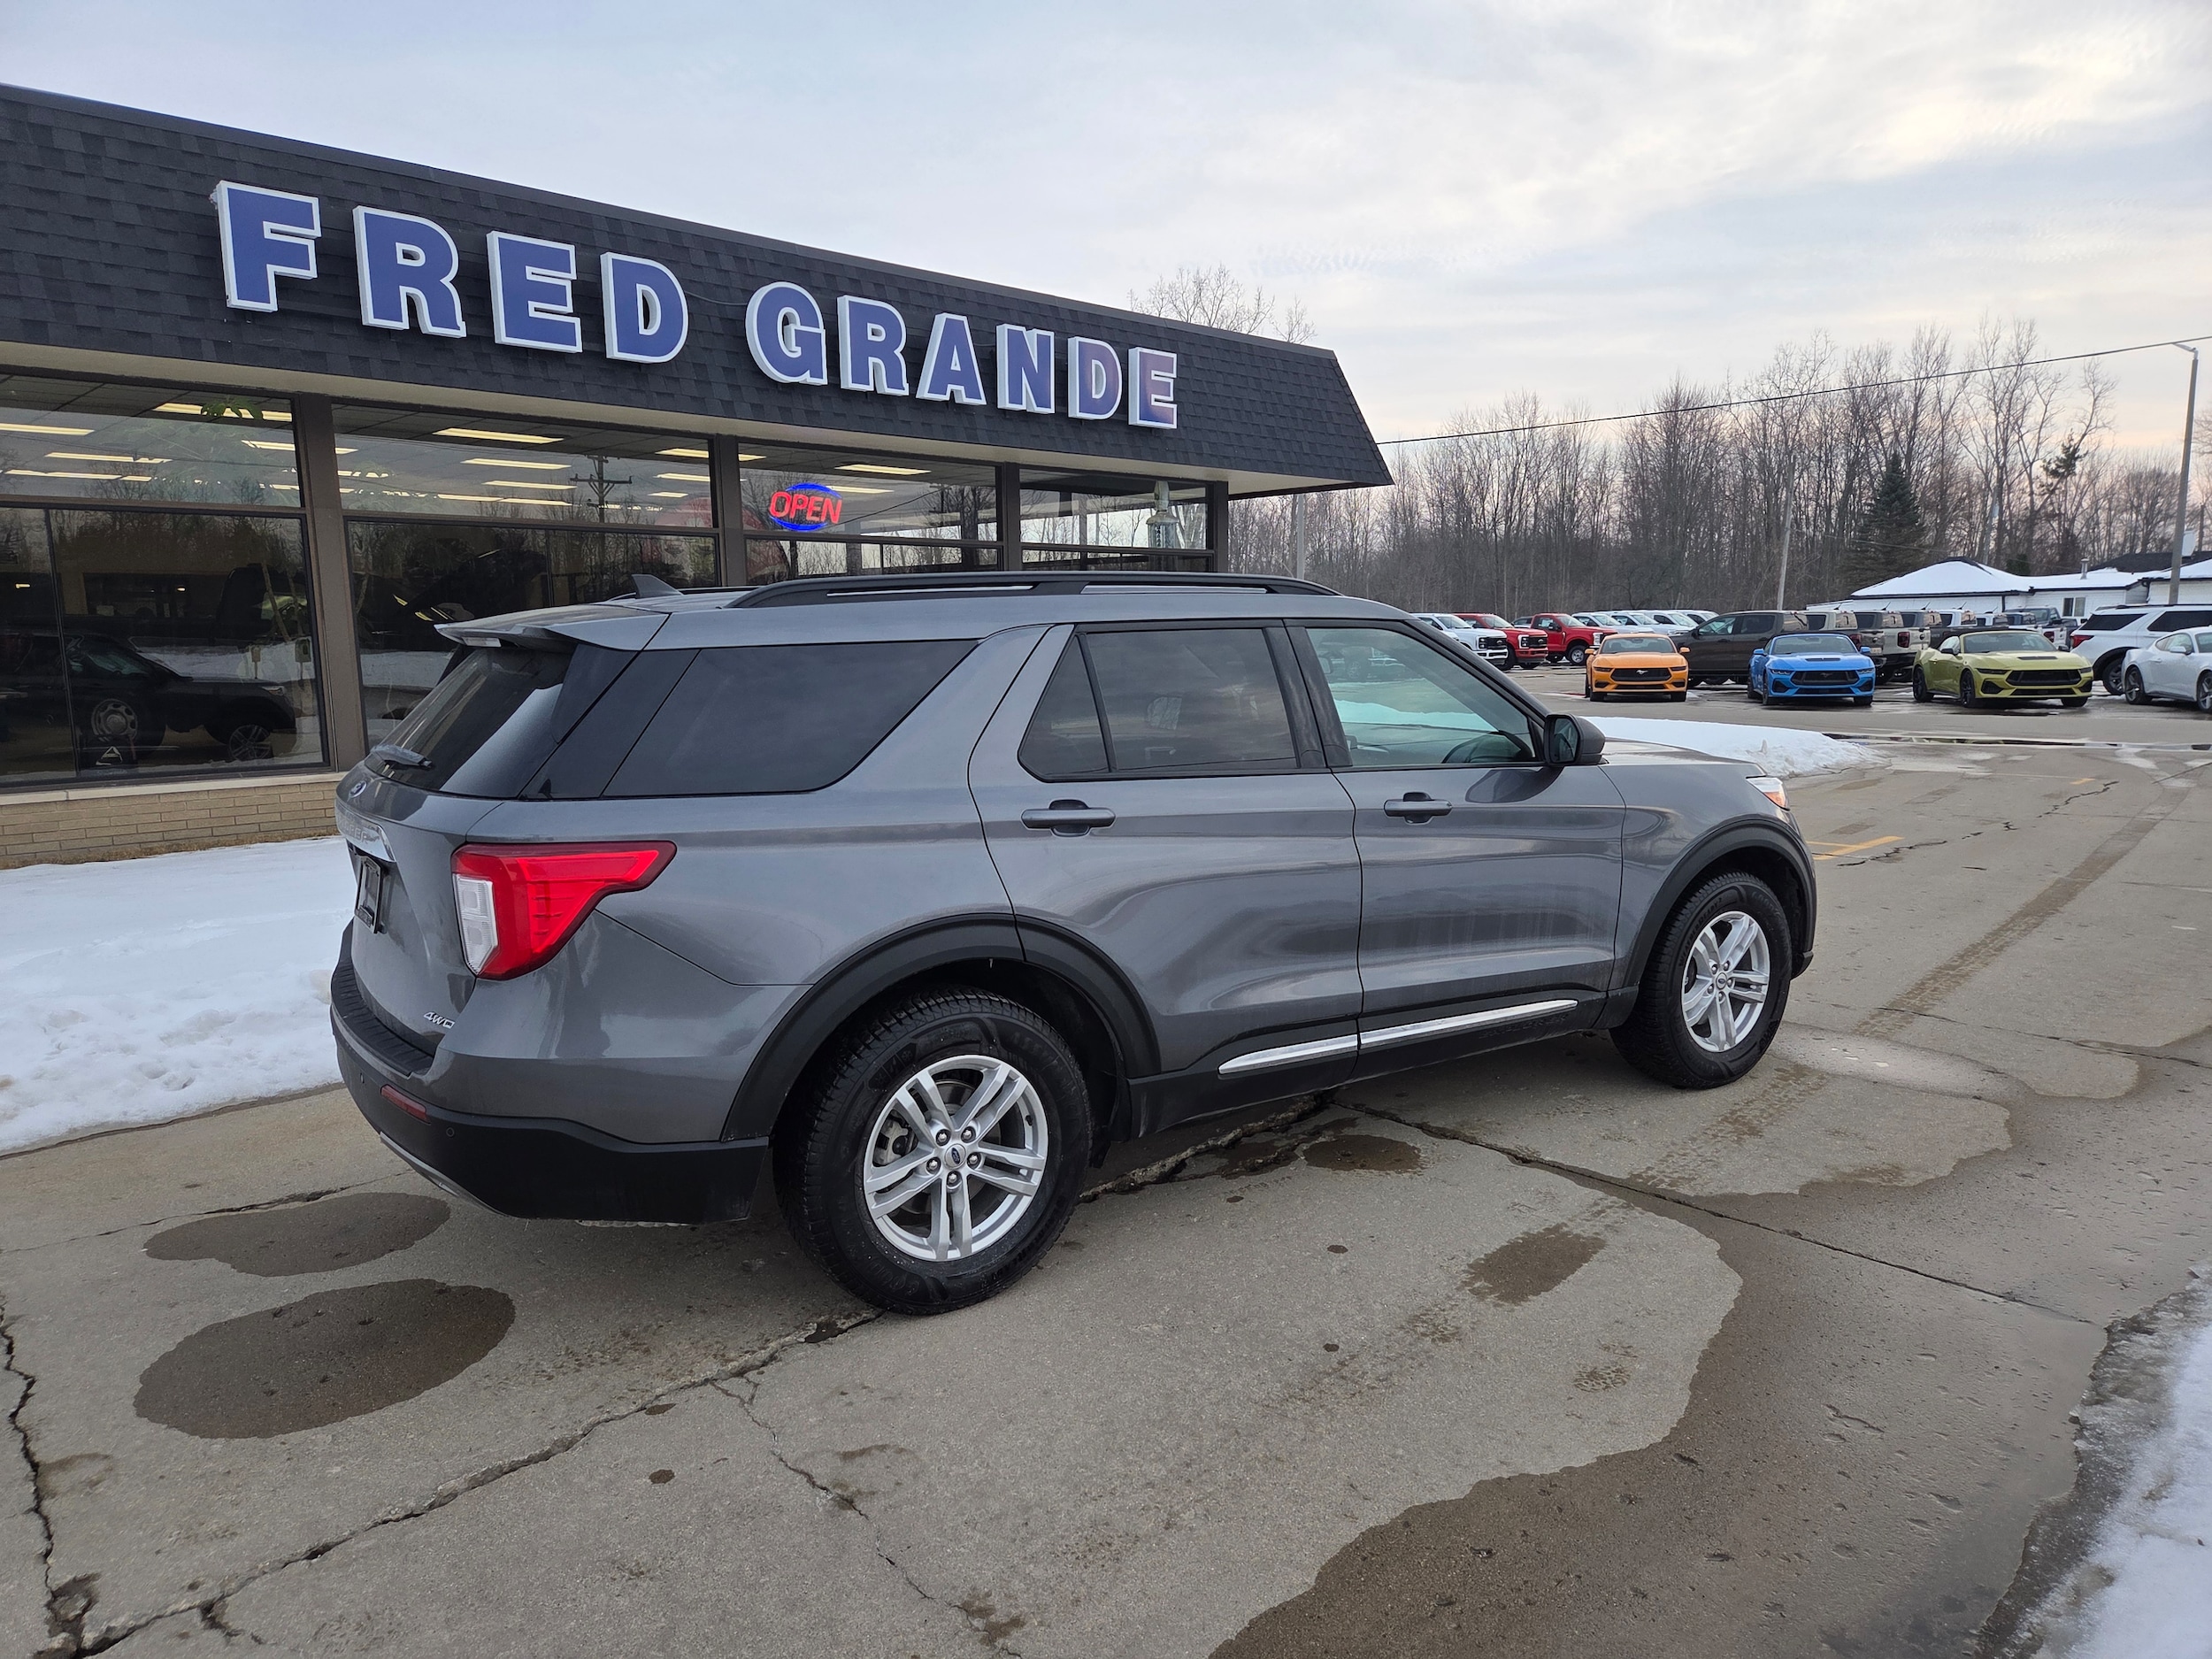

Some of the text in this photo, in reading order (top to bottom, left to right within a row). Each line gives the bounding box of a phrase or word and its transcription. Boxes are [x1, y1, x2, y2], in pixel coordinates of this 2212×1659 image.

[217, 180, 1177, 429] FRED GRANDE
[769, 491, 842, 524] OPEN
[424, 1011, 455, 1029] 4WD
